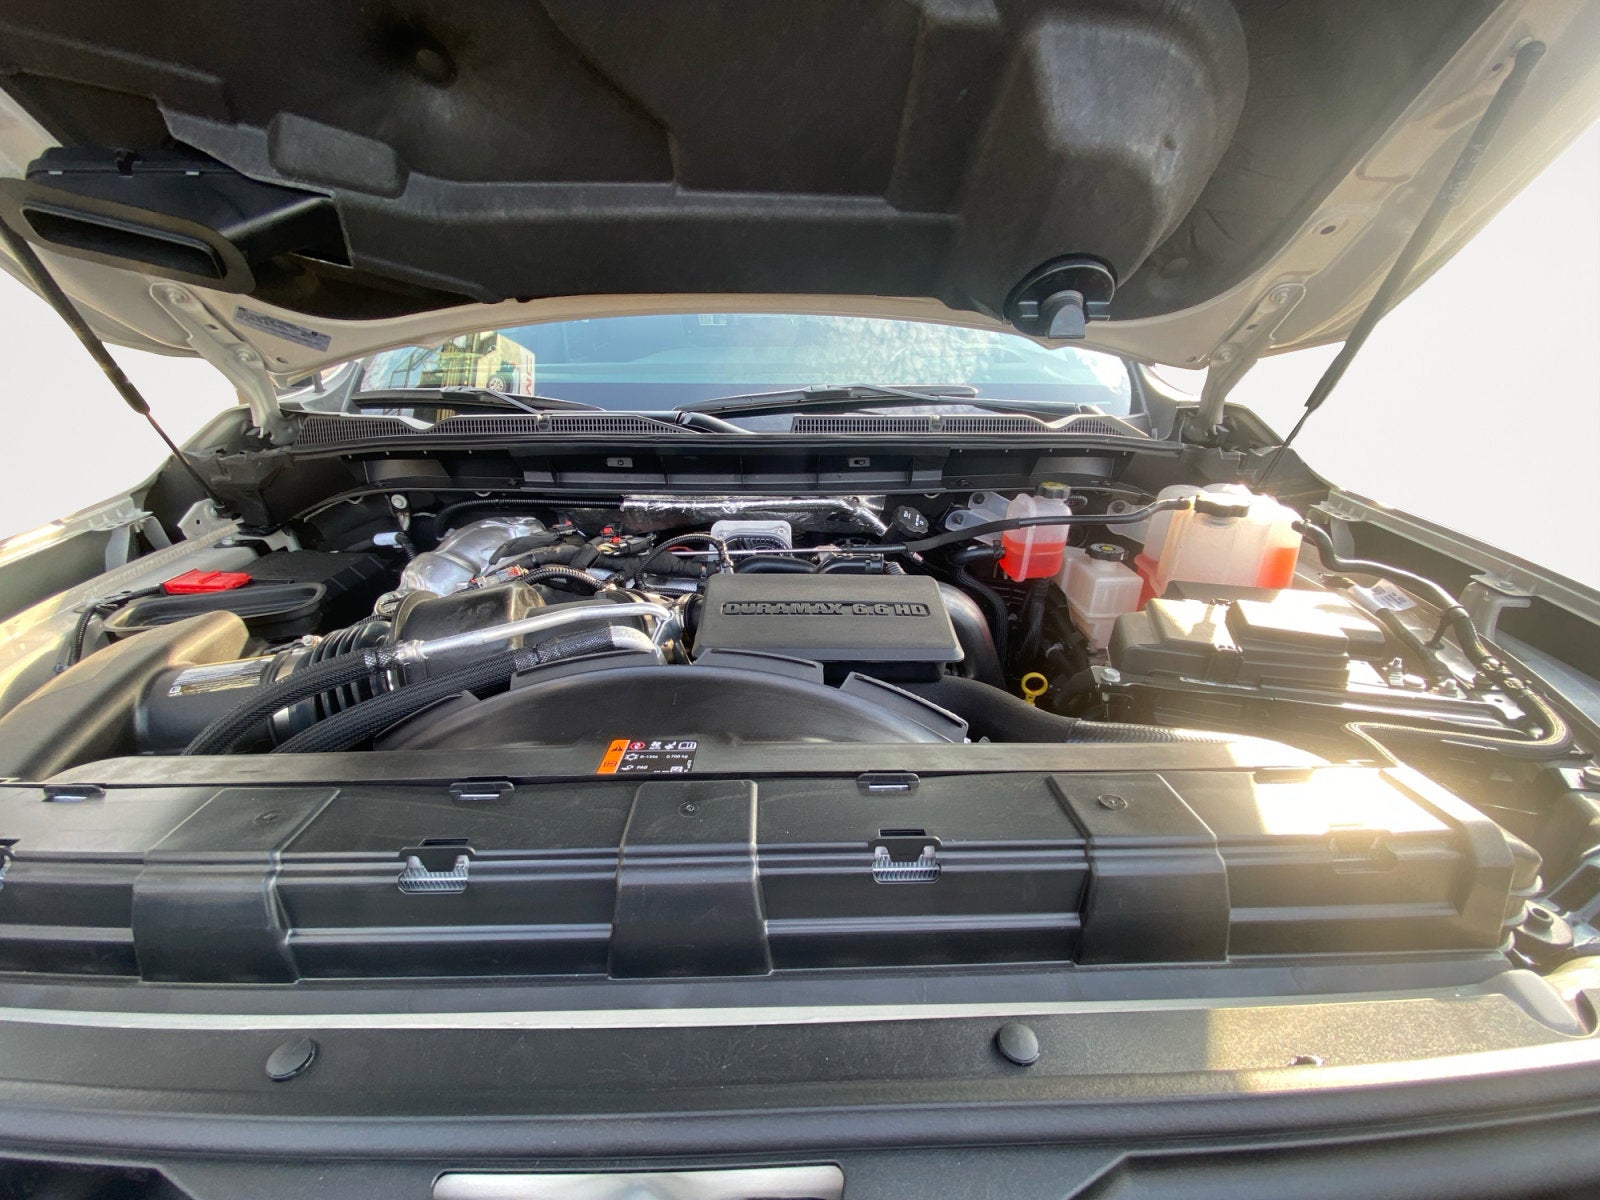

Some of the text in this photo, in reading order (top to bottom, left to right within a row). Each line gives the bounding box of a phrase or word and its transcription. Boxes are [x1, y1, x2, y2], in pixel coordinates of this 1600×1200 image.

[724, 603, 929, 616] DURAMAX 6.6 HD
